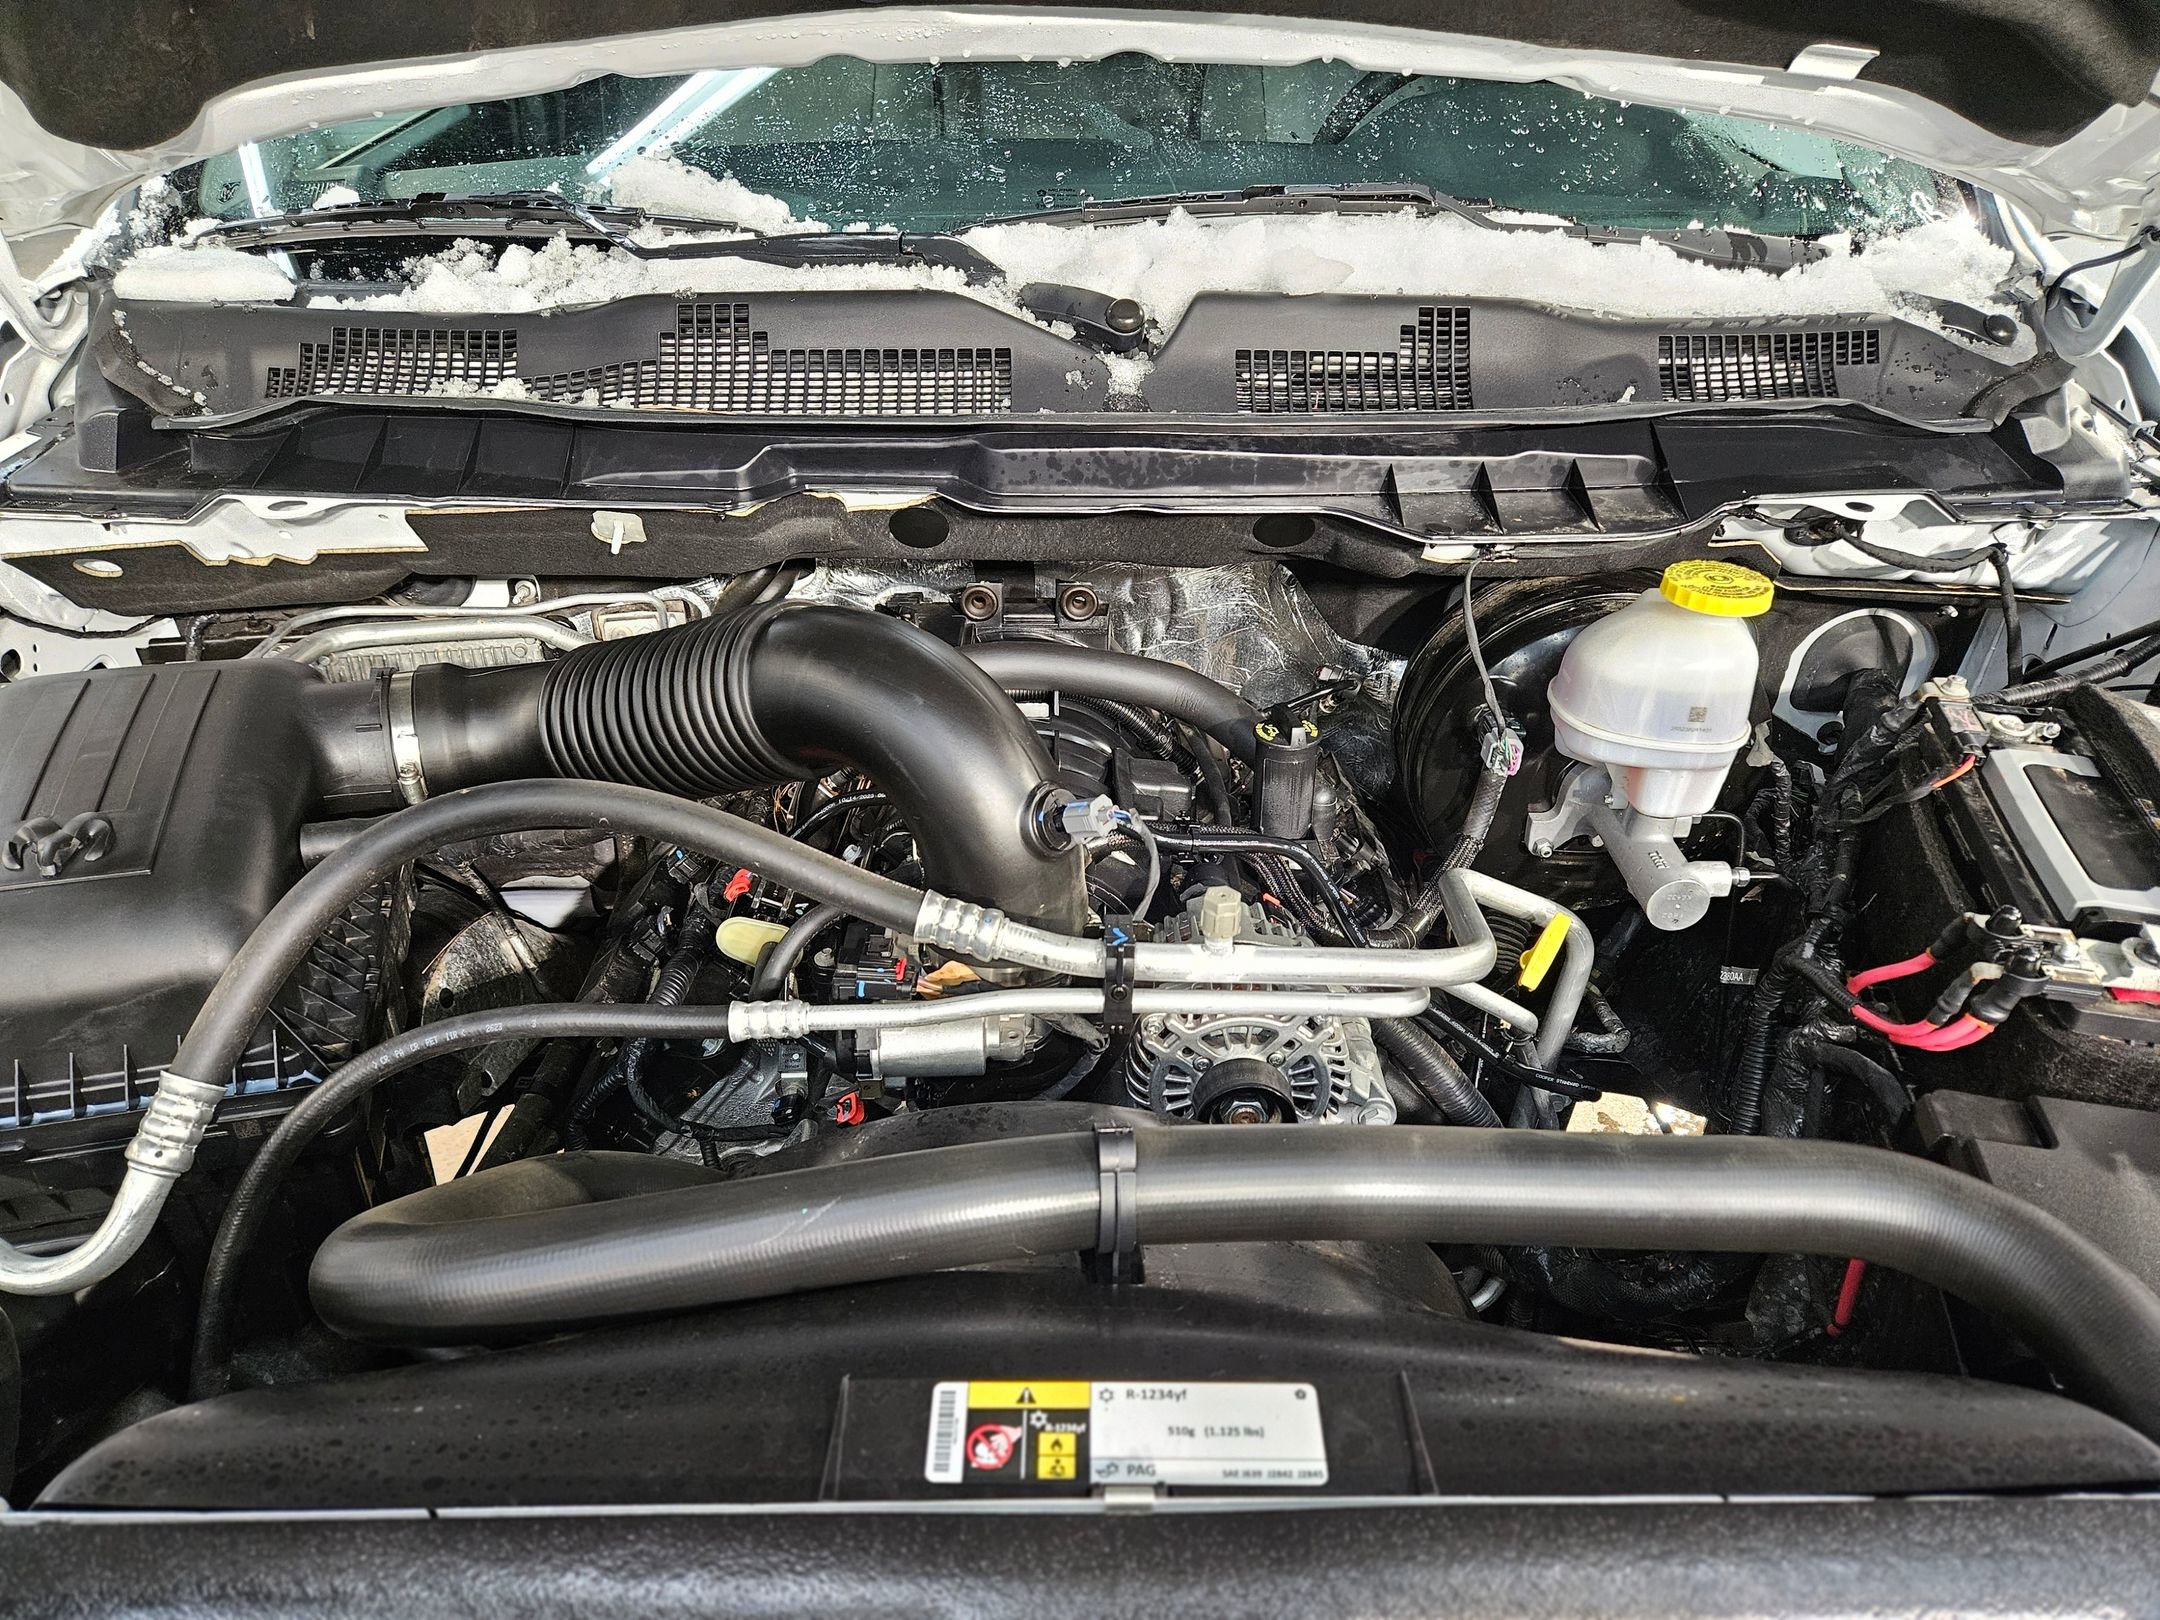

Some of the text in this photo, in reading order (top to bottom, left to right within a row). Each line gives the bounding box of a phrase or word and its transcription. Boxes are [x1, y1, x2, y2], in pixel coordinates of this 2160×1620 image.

[1535, 1073, 1555, 1082] COOPER
[1556, 1078, 1579, 1088] STANDARD
[1126, 1388, 1187, 1402] R-1234yf
[1167, 1426, 1195, 1438] 510g
[1204, 1426, 1241, 1439] (1.125
[1126, 1463, 1156, 1477] PAG
